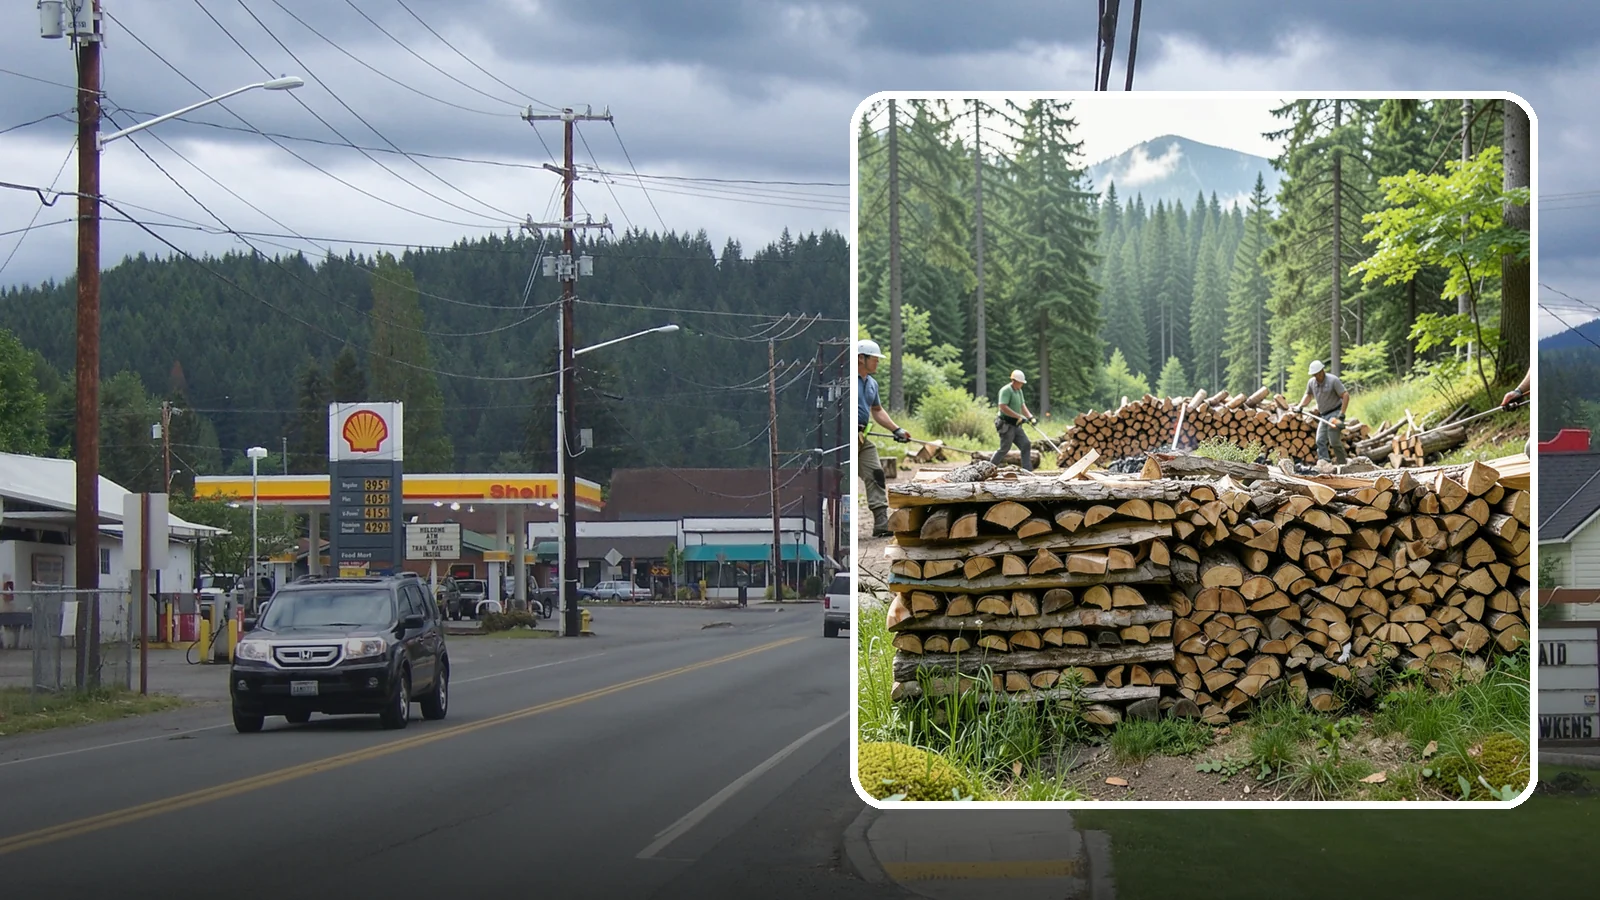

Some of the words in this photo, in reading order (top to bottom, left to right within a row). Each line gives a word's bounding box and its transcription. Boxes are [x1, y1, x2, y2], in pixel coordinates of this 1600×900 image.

[366, 480, 383, 490] 395
[490, 484, 547, 498] Shell
[366, 494, 383, 504] 405
[366, 508, 383, 517] 415
[366, 522, 383, 532] 429
[1539, 642, 1567, 666] AID
[1540, 716, 1592, 738] WKENS
